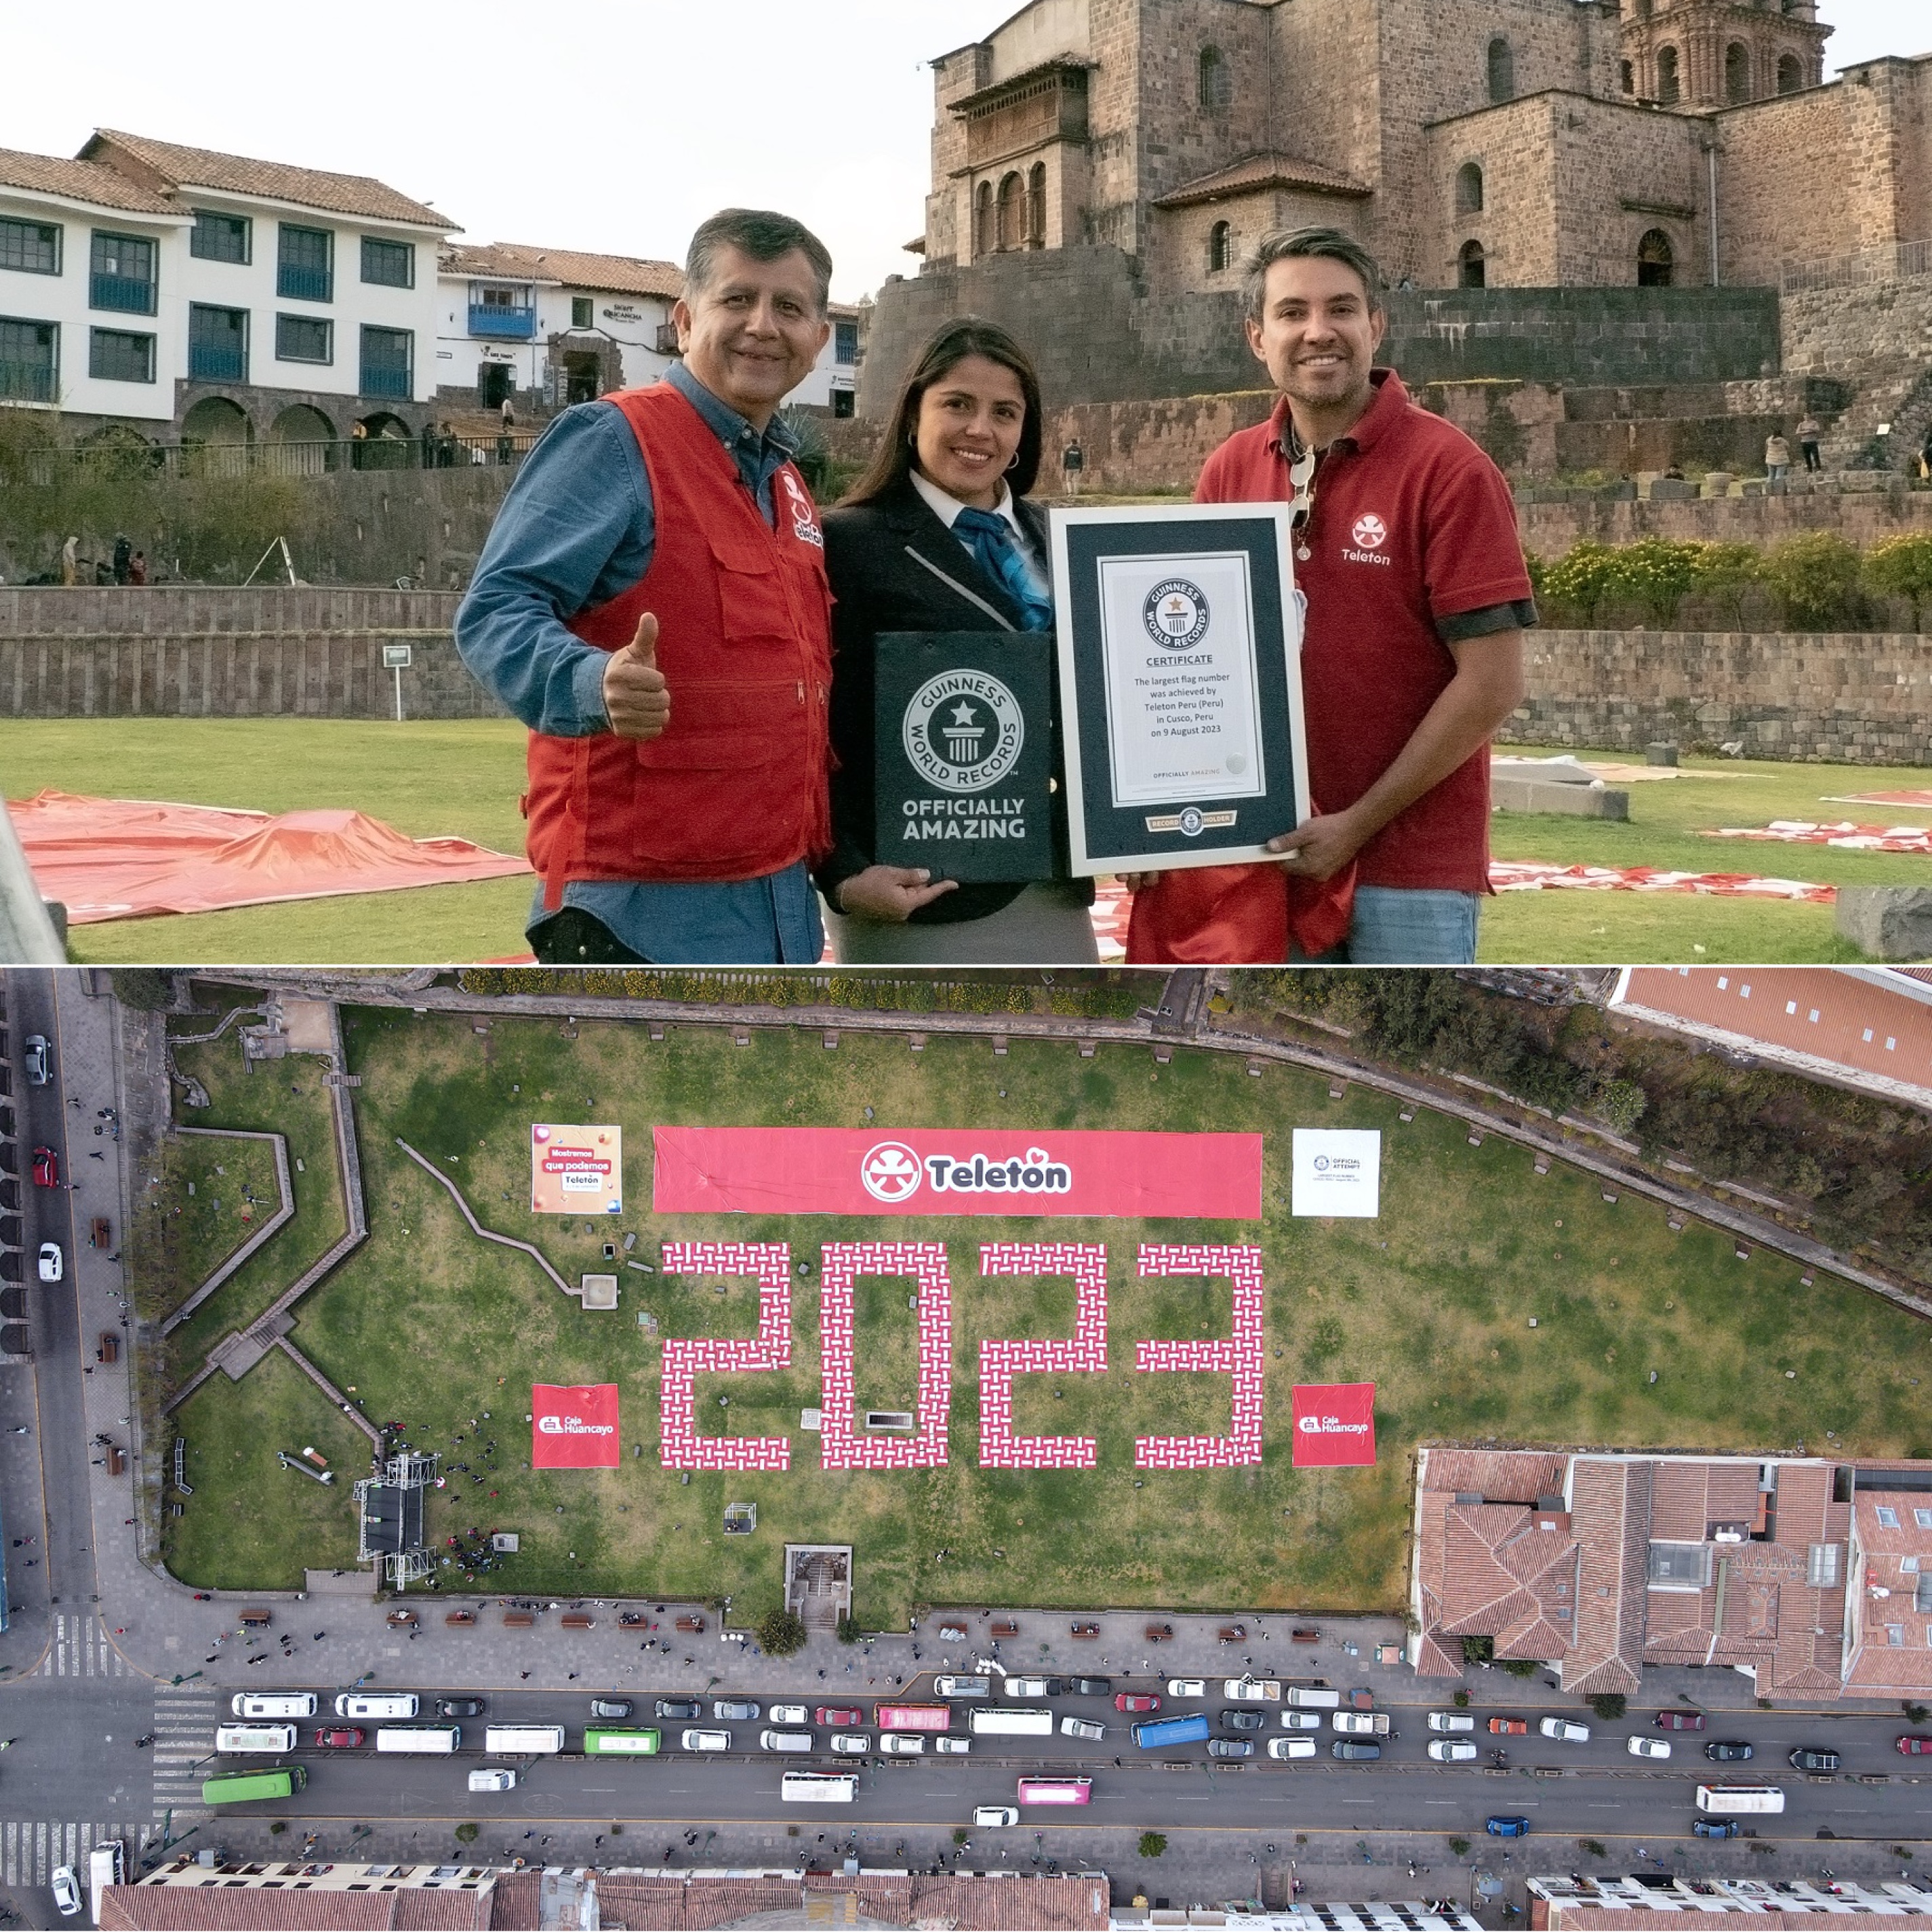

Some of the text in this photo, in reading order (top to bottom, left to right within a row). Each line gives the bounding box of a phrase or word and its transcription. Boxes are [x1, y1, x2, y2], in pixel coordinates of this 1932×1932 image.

[1151, 582, 1200, 603] GUINNESS
[1146, 609, 1206, 647] WORLD RECORDS
[1146, 654, 1213, 666] CERTIFICATE
[1134, 673, 1230, 687] The largest flag number
[921, 677, 1007, 708] GUINNESS
[1169, 687, 1205, 697] achieved
[1206, 686, 1217, 696] by
[1144, 698, 1224, 712] Teleton Peru (Peru)
[1156, 713, 1213, 724] in Cusco, Peru
[1163, 728, 1169, 736] 9
[1171, 727, 1199, 737] August
[1201, 724, 1222, 734] 2023
[911, 723, 1016, 784] WORLD RECORDS
[1153, 768, 1221, 779] OFFICIALLY AMAZING
[902, 799, 1025, 816] OFFICIALLY
[1152, 814, 1231, 828] RECORD HOLDER
[902, 818, 1026, 841] AMAZING
[545, 1161, 609, 1171] que podemos
[661, 1241, 1264, 1470] 2023
[564, 1415, 582, 1426] Caja
[564, 1424, 614, 1436] Huancayo
[1321, 1424, 1369, 1435] Huancayo
